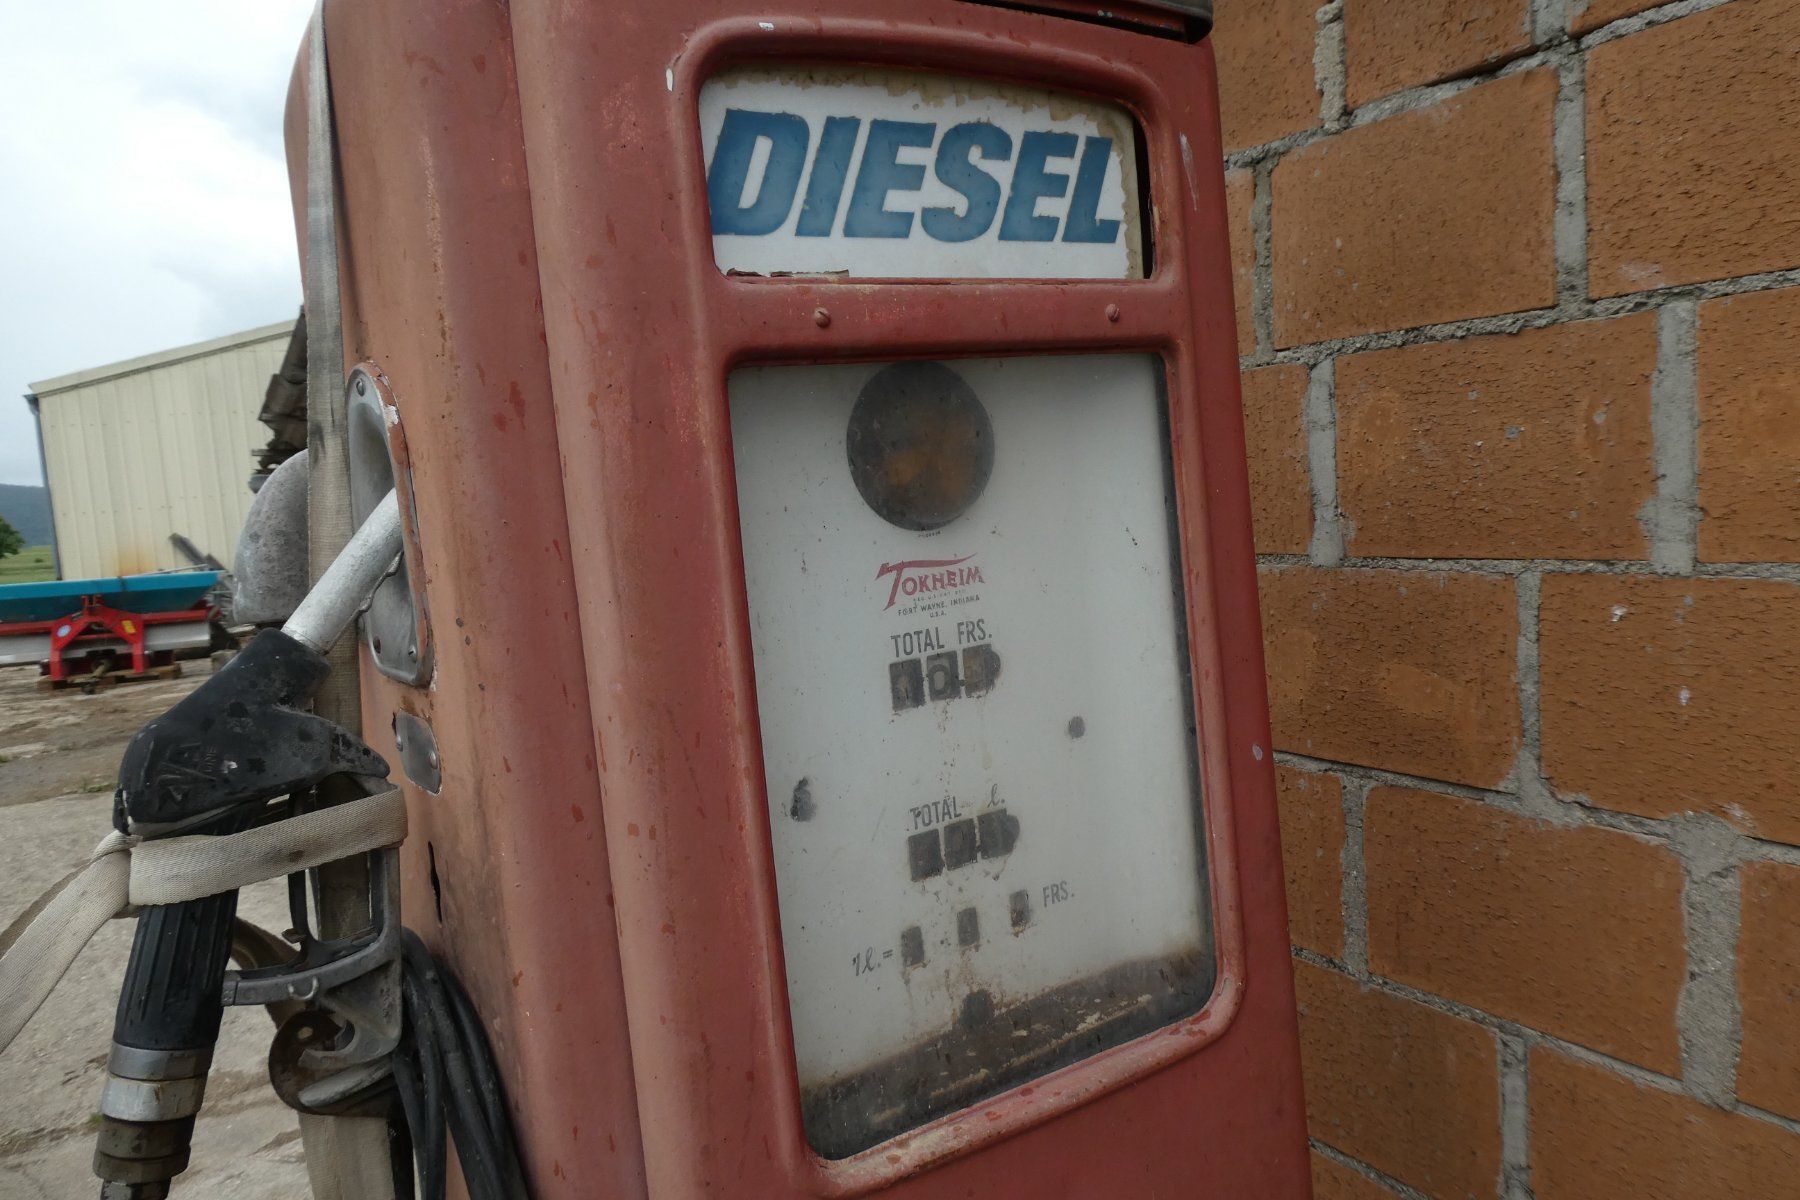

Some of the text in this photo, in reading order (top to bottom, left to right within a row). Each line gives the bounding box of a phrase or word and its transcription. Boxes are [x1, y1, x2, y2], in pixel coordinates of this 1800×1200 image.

[708, 108, 1121, 244] DIESEL
[874, 552, 986, 612] TOKHEIM
[898, 606, 918, 617] FORT
[950, 594, 980, 606] INDIANA
[890, 618, 993, 658] TOTAL FRS.
[909, 796, 962, 831] TOTAL
[1042, 880, 1075, 908] FRS.
